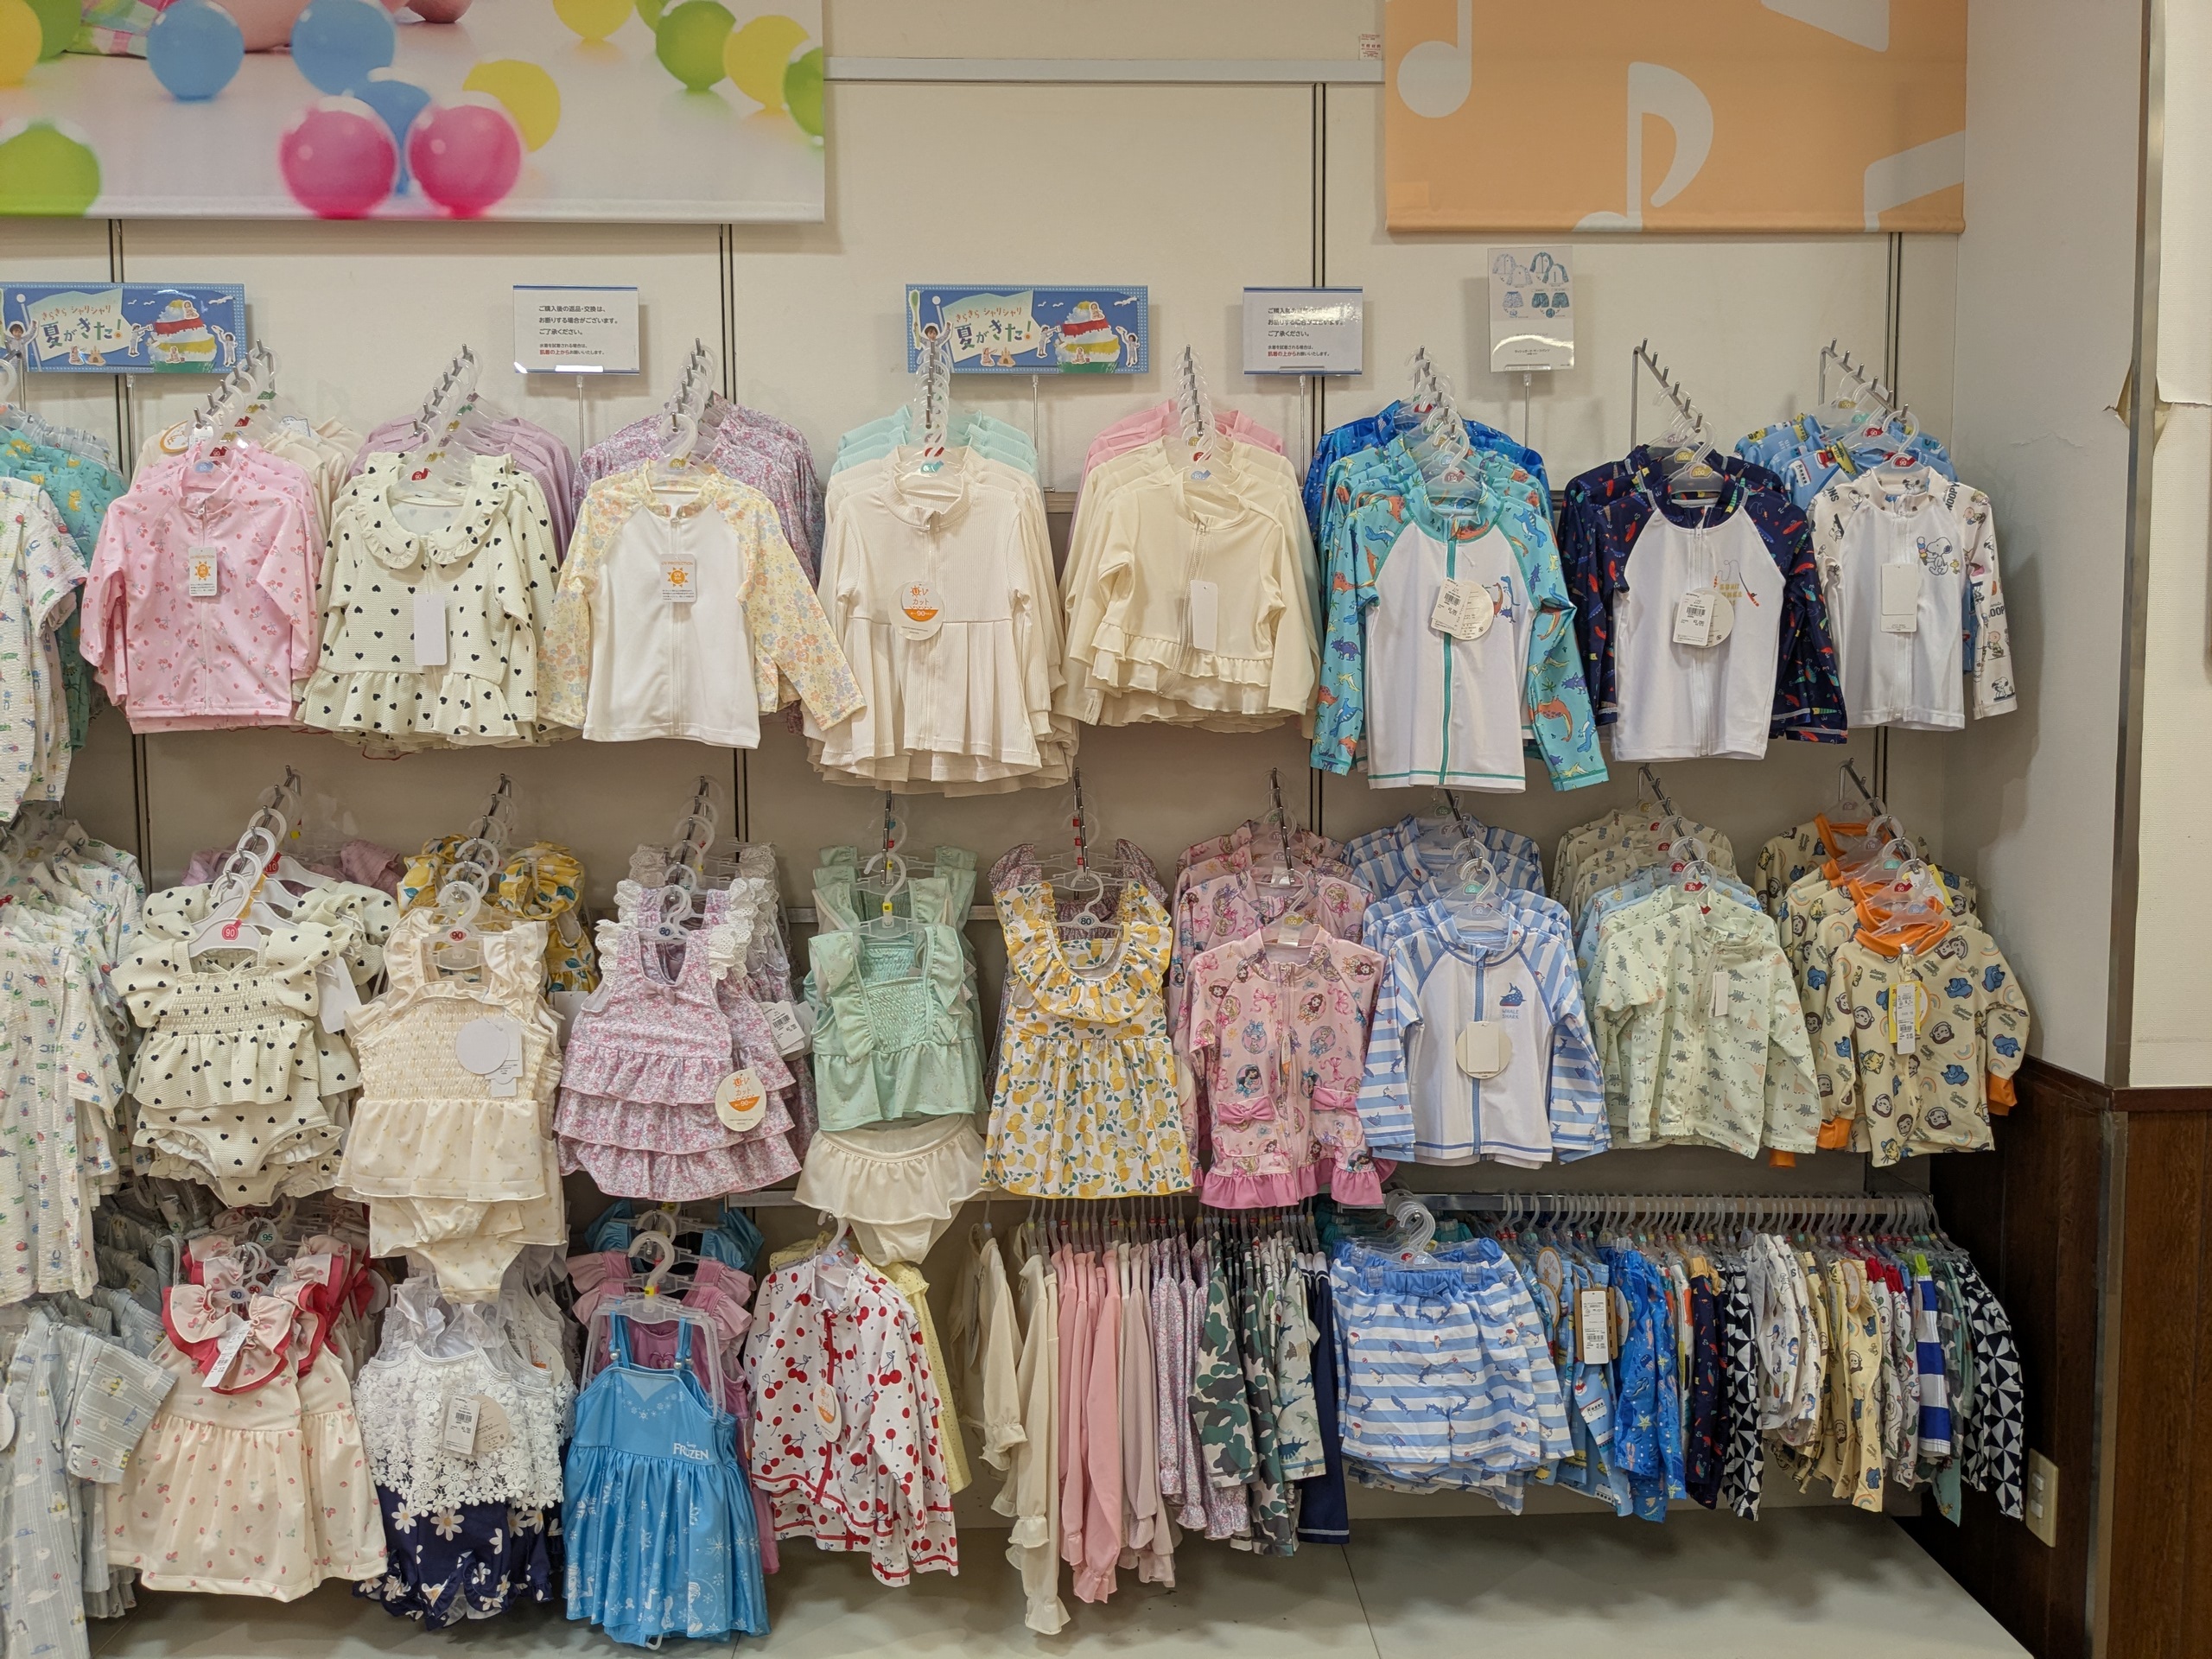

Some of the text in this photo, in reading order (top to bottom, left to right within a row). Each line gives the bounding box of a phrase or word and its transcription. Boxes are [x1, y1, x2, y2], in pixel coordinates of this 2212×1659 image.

[956, 307, 1022, 323] きらきら シャリシャリ
[1080, 917, 1092, 925] 80
[225, 928, 236, 938] 90
[658, 926, 671, 937] 80
[262, 1233, 273, 1242] 95
[230, 1290, 242, 1299] 80
[673, 1442, 709, 1461] FROZEN
